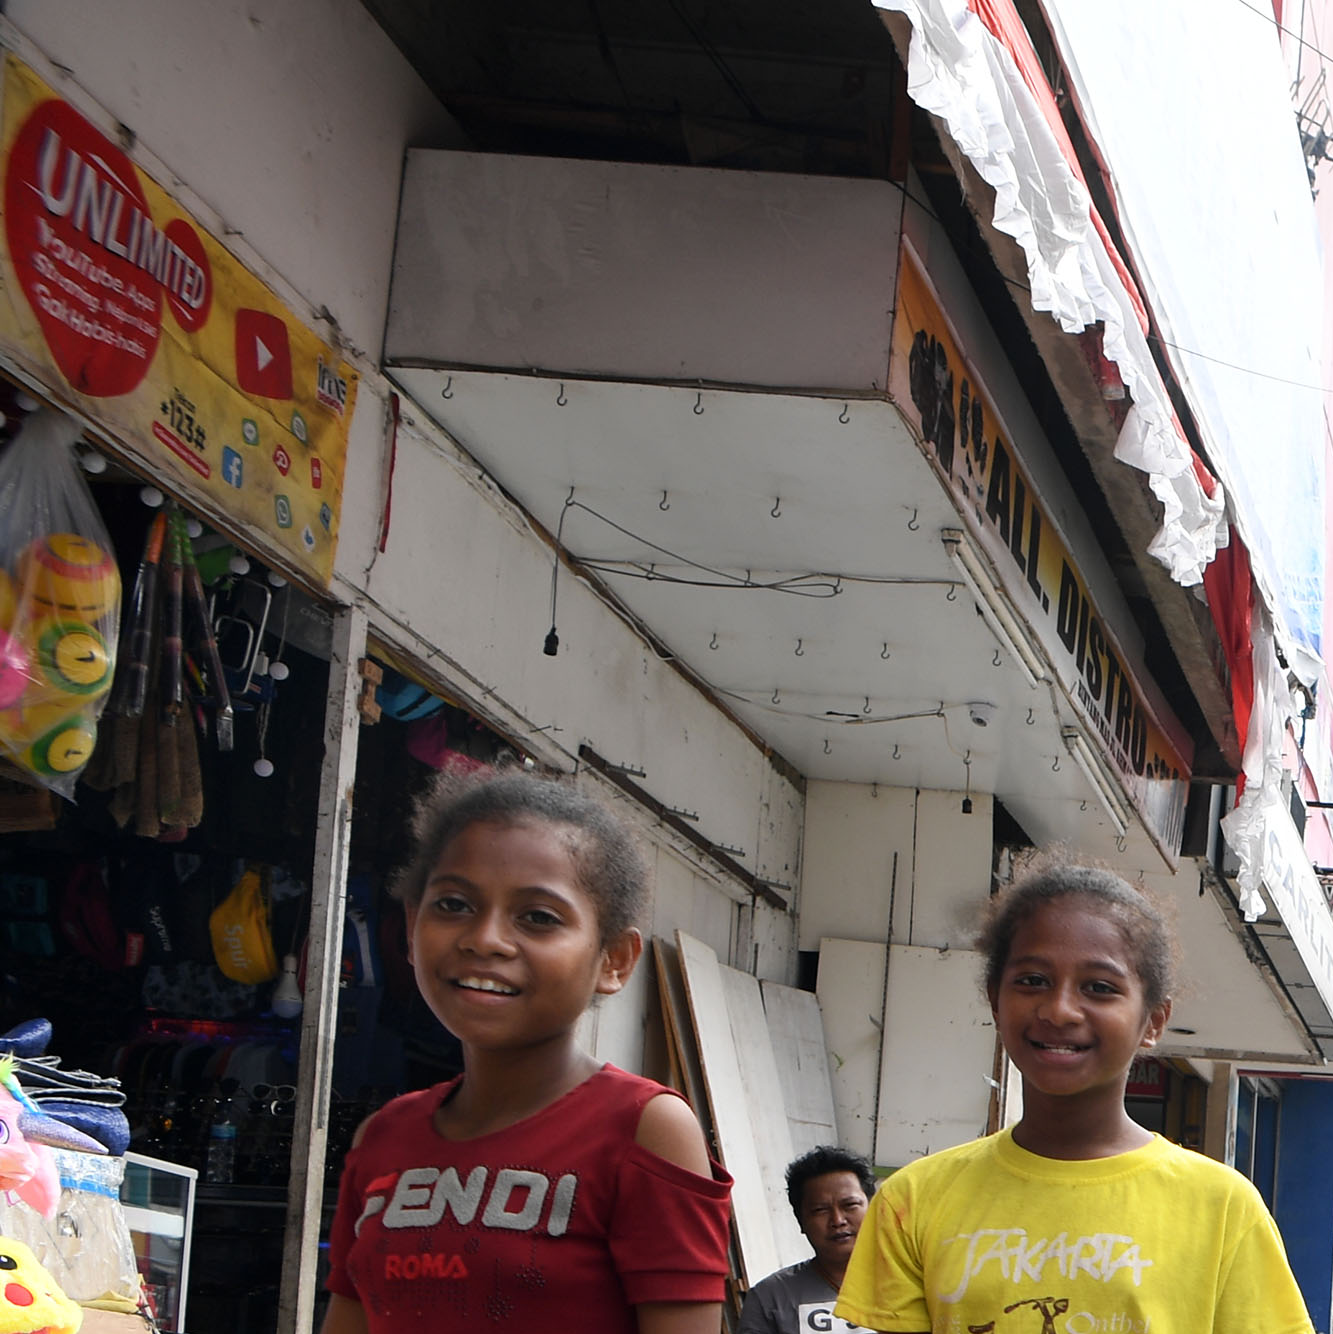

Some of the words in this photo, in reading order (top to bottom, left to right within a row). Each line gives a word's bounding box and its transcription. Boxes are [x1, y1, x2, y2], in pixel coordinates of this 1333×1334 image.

[38, 126, 205, 310] UNLIMITED
[1057, 558, 1148, 777] DISTRO
[354, 1166, 577, 1237] FENDI
[385, 1253, 469, 1280] ROMA
[936, 1228, 1153, 1304] JAKARTA
